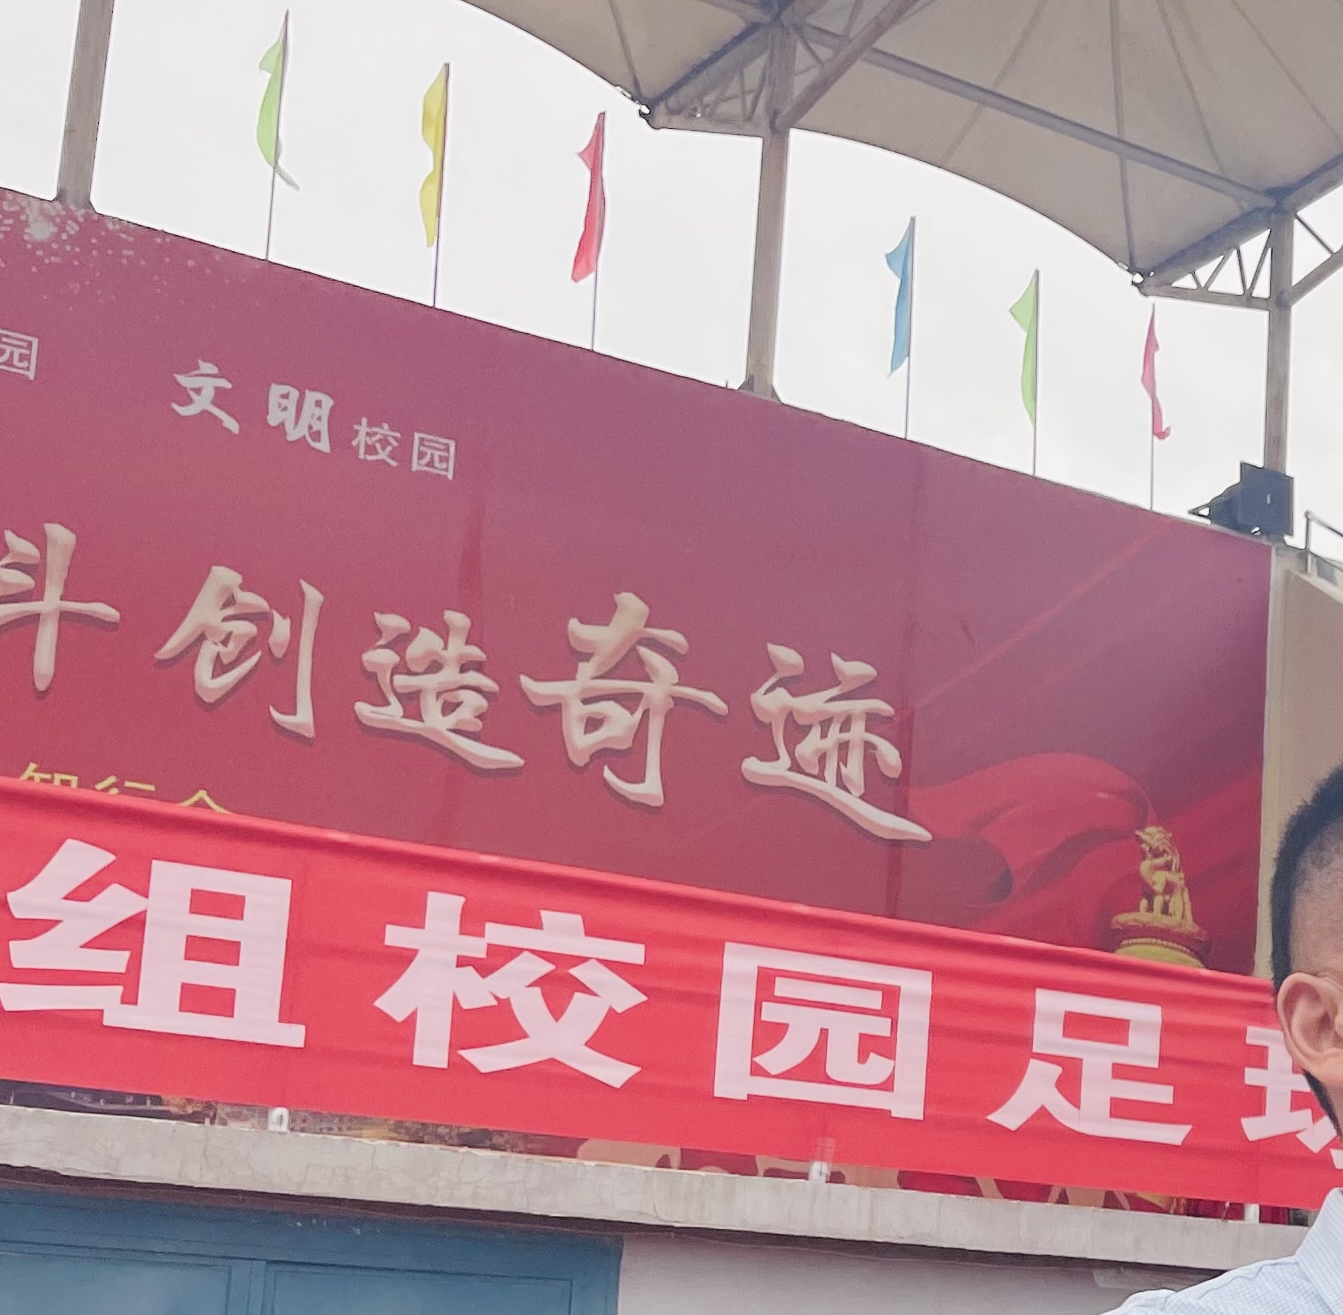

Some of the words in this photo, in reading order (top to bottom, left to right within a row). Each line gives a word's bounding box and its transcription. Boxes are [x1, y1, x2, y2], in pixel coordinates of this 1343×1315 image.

[170, 359, 457, 480] 文明校园
[0, 522, 932, 843] 斗创造奇迹
